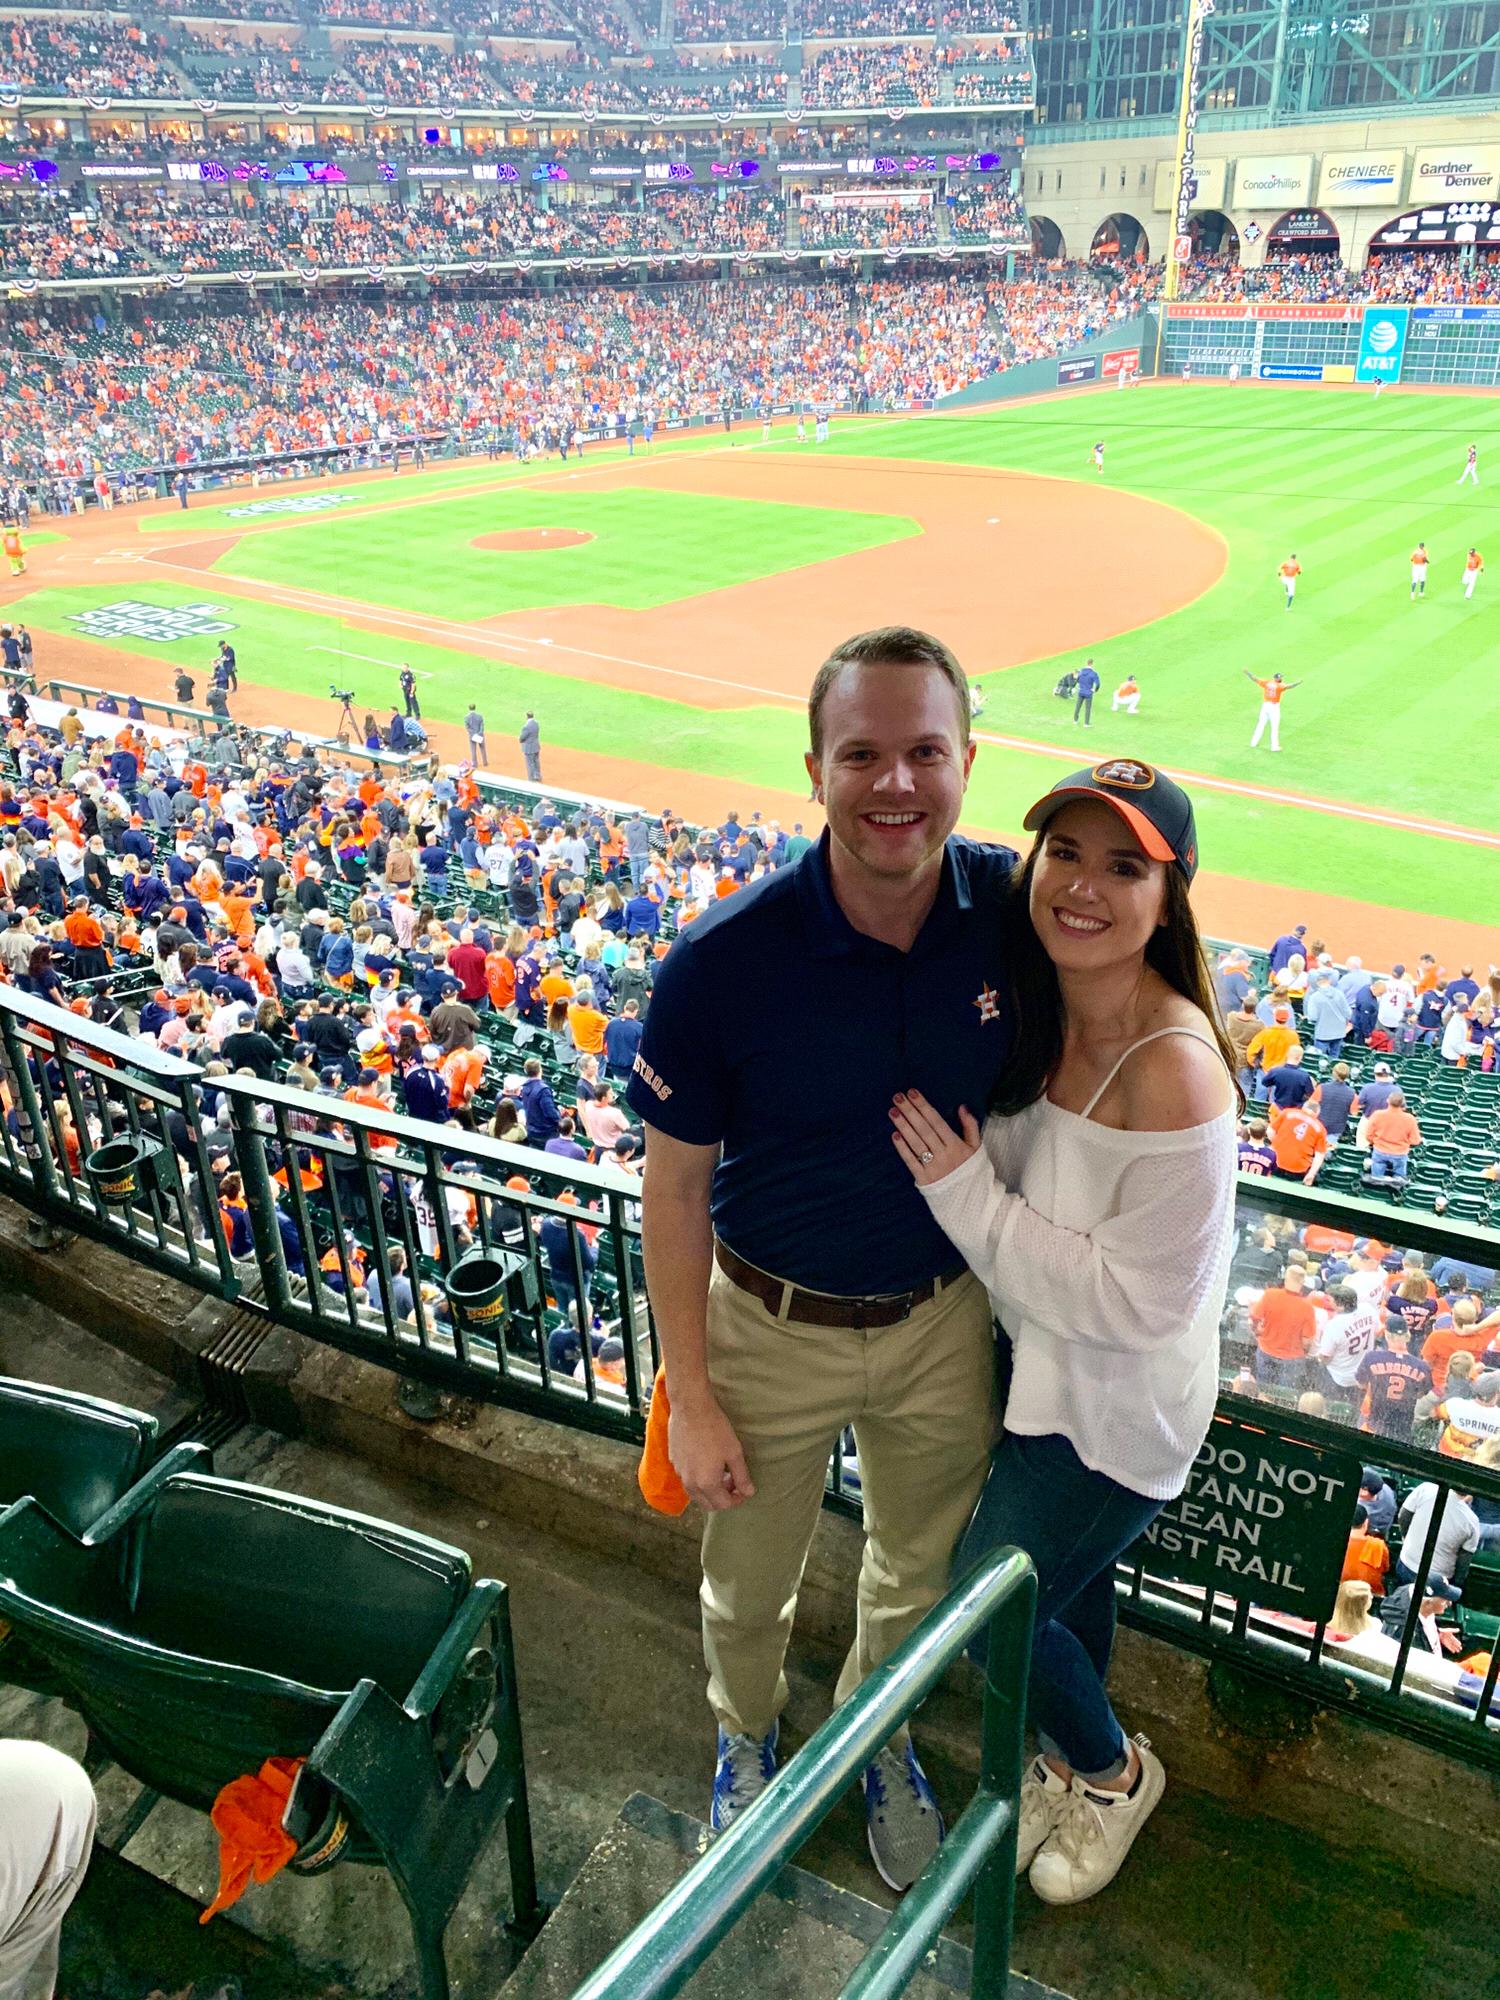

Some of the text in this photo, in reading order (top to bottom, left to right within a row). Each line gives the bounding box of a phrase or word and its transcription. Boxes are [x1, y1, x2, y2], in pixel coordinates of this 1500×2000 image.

[1186, 32, 1203, 128] CHIKIN
[1328, 164, 1397, 179] CHENIERE
[1420, 162, 1472, 175] Gardner
[1445, 175, 1493, 187] Denver
[1243, 178, 1302, 190] ConocoPhillips
[1177, 168, 1193, 234] FARE
[1361, 356, 1398, 370] AT&T
[67, 610, 194, 642] SERIES
[100, 600, 238, 635] WORLD
[1293, 1122, 1309, 1140] 4
[469, 1302, 501, 1318] SONIC
[1343, 1315, 1374, 1339] ALTUVE
[1348, 1329, 1371, 1356] 27
[1386, 1375, 1405, 1400] 2
[1194, 1441, 1345, 1502] DO NOT
[1183, 1470, 1285, 1519] TAND
[1144, 1522, 1306, 1593] NST RAIL
